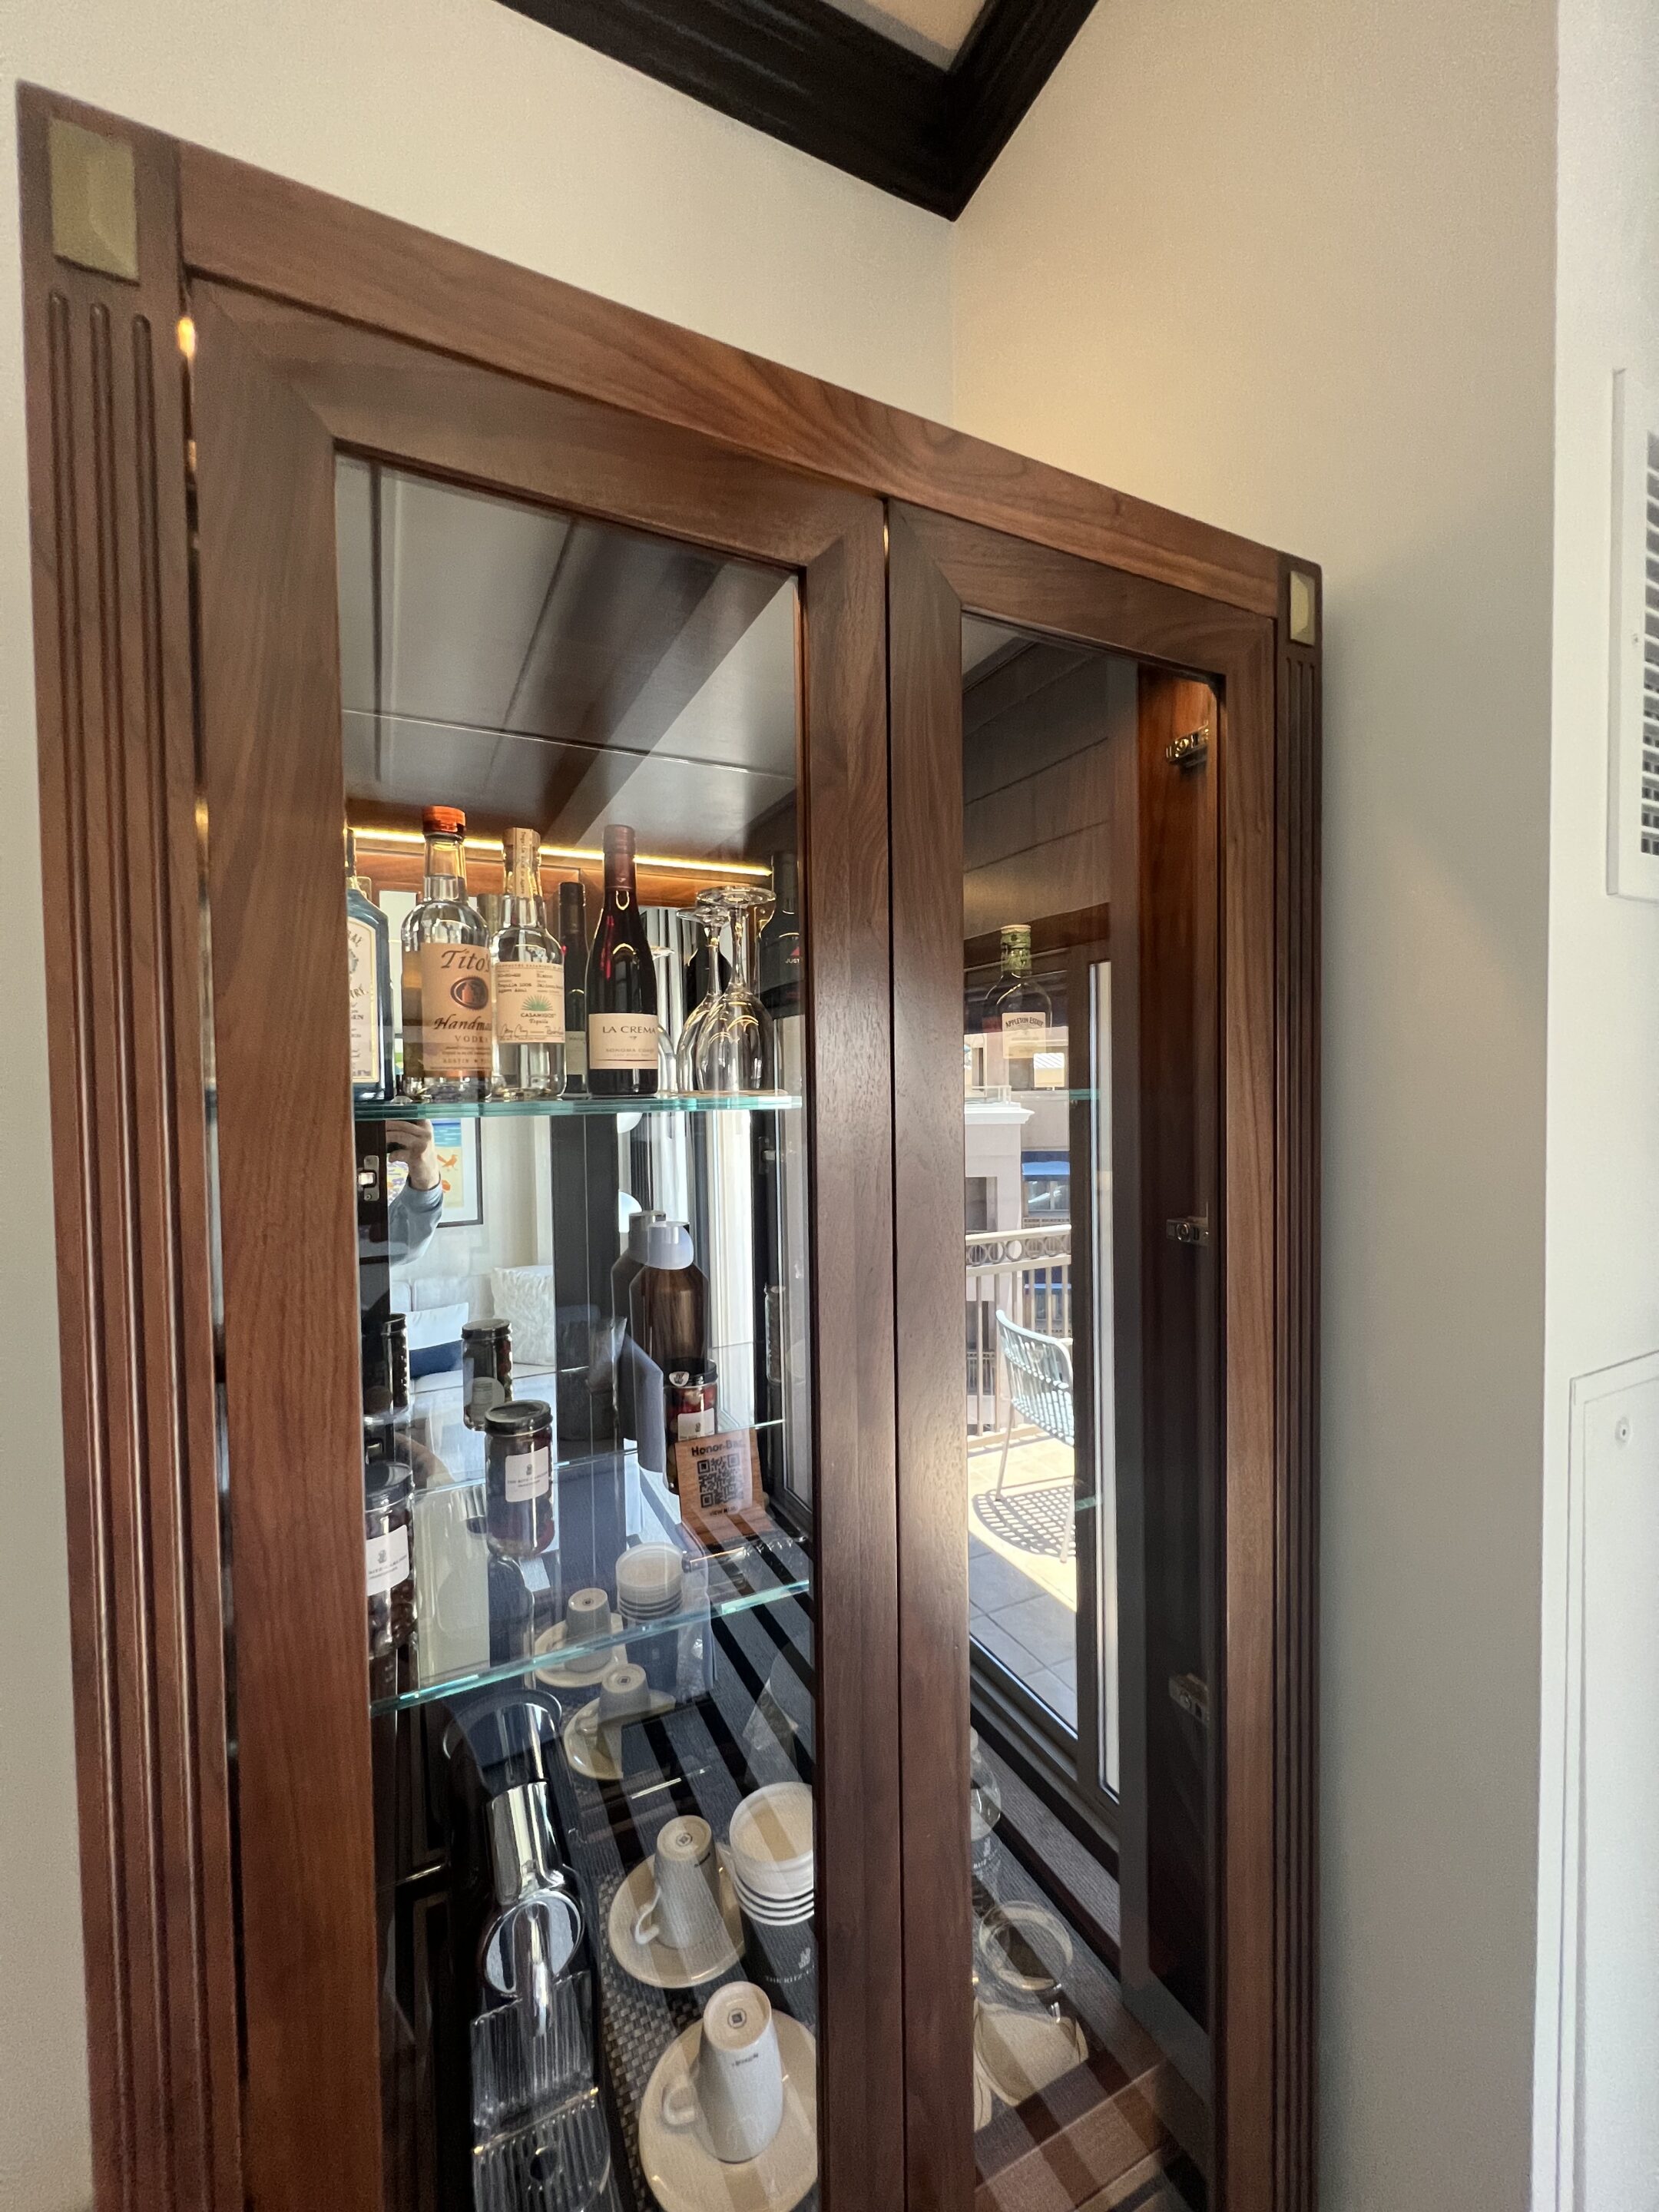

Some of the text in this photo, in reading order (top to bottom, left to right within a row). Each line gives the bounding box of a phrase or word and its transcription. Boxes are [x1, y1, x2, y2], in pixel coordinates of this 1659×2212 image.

[1005, 1018, 1029, 1028] APPLETON
[621, 1025, 656, 1035] CREMA
[691, 1443, 724, 1456] Honor
